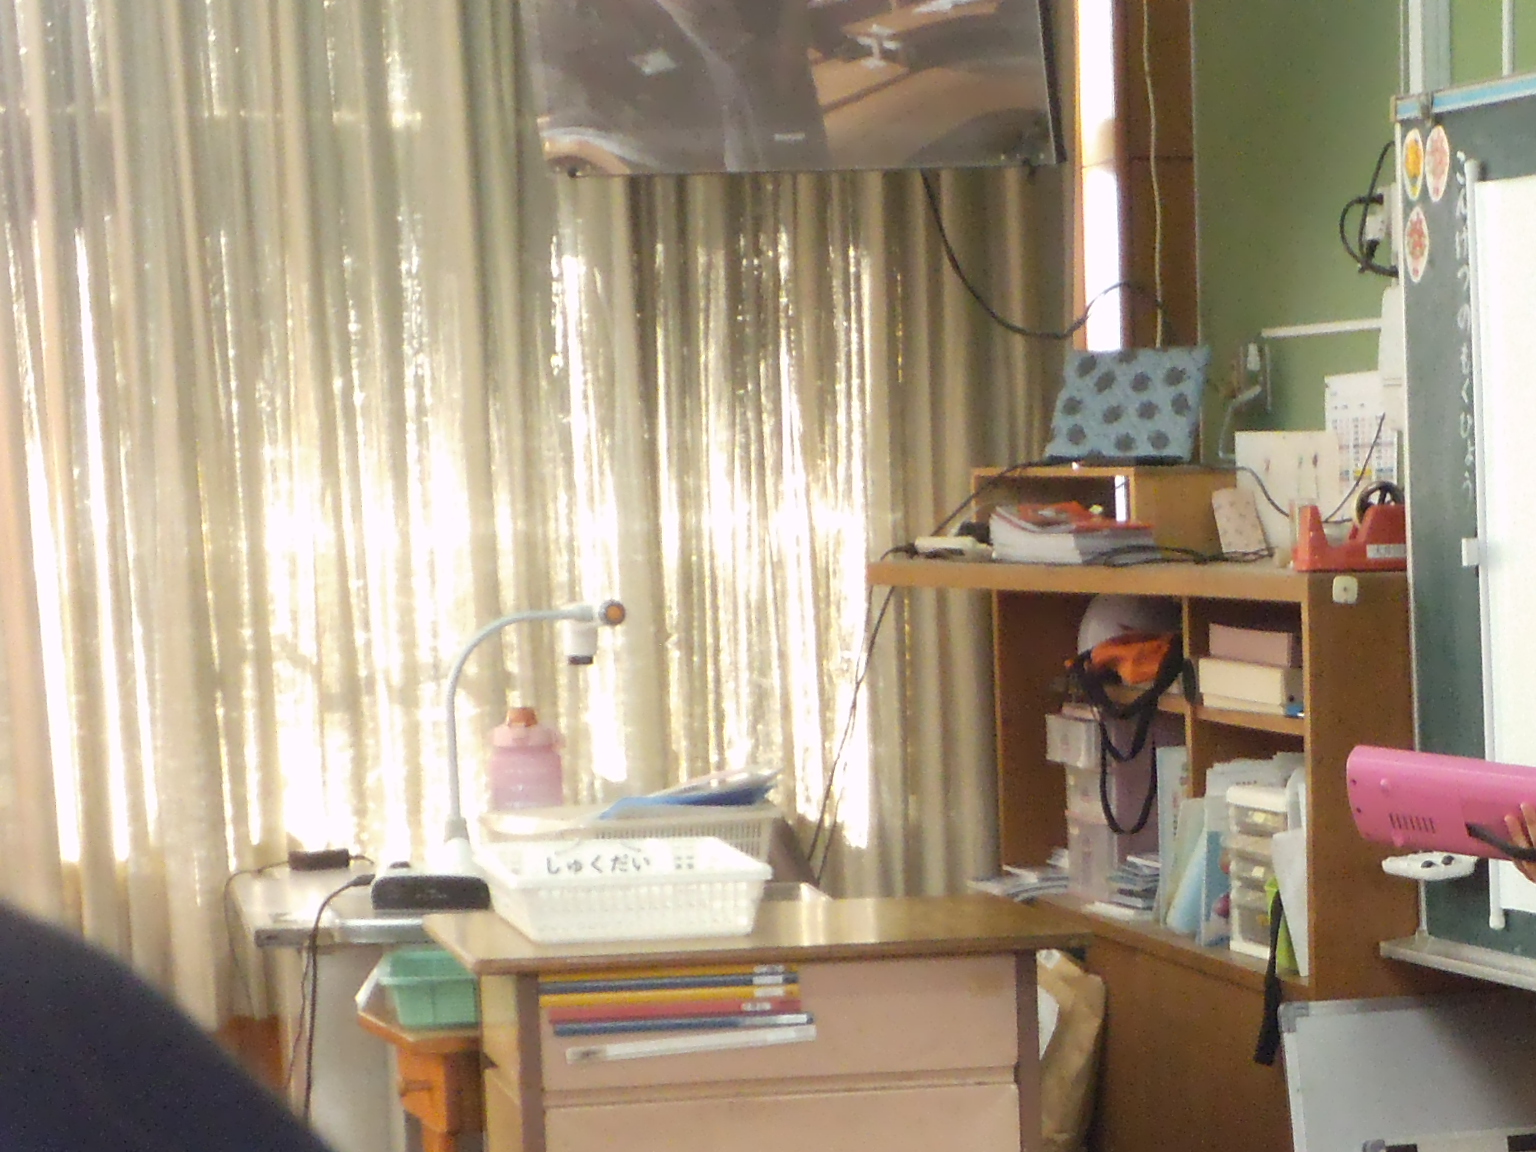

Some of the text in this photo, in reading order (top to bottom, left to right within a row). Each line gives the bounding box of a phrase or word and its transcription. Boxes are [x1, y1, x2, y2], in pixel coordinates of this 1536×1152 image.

[545, 852, 652, 875] しゅくだい
